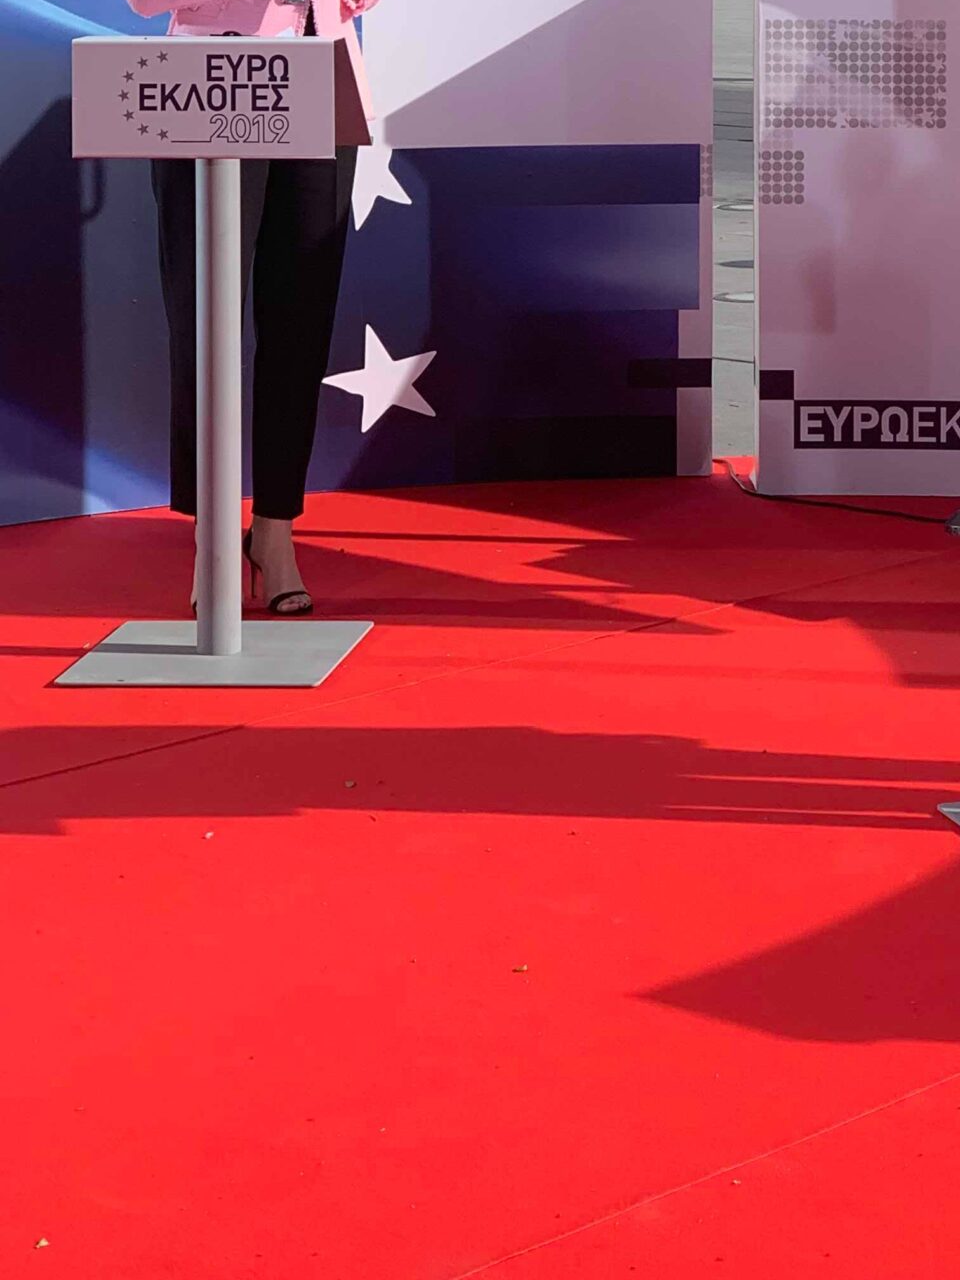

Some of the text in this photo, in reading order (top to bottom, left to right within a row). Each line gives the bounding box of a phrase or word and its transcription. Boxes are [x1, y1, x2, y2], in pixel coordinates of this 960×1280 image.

[205, 54, 290, 82] ΕΥΡΩ
[138, 83, 290, 112] ΕΚΛΟΓΕΣ
[209, 113, 290, 143] 2019
